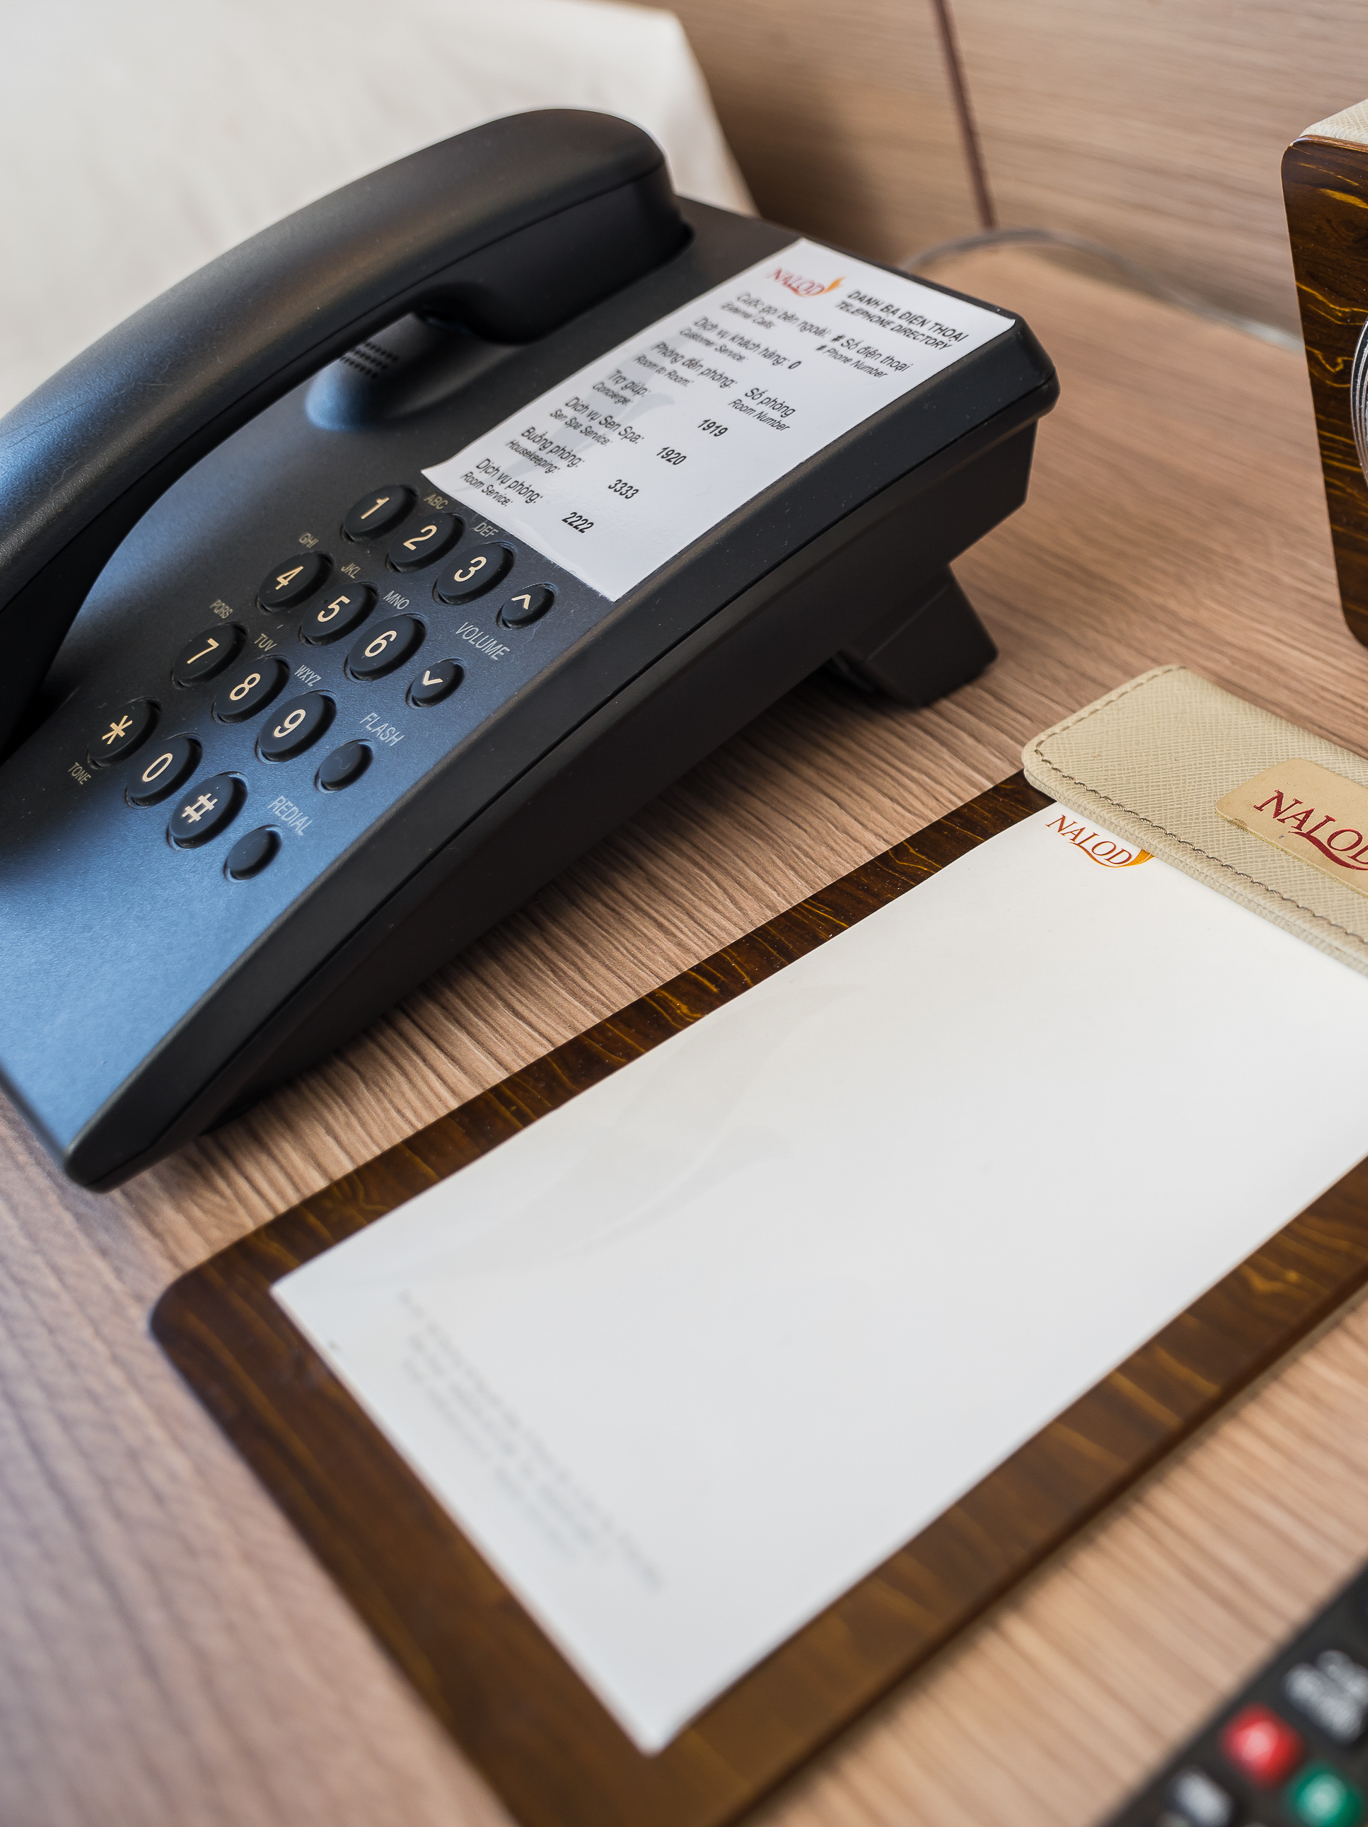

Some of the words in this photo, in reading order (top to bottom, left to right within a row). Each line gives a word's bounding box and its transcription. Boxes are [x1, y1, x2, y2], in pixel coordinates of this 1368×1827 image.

[768, 267, 832, 297] NALOD
[835, 300, 894, 329] TELEPHONE
[890, 323, 952, 350] DIRECTORY
[848, 290, 881, 309] DANH
[880, 304, 900, 317] BẠ
[899, 310, 932, 328] ĐIỆN
[930, 321, 969, 342] THOẠI
[634, 353, 663, 374] Room
[824, 348, 852, 365] Phone
[852, 359, 888, 378] Number
[841, 338, 864, 351] Số
[857, 344, 882, 360] điện
[880, 355, 914, 372] thoại
[729, 398, 756, 415] Room
[754, 408, 791, 432] Number
[745, 387, 768, 400] Số
[760, 395, 796, 418] phòng
[550, 408, 568, 422] Sen
[565, 417, 582, 430] Spa
[580, 424, 613, 447] Service:
[565, 396, 589, 416] Dịch
[586, 410, 601, 422] vụ
[599, 415, 620, 433] Sen
[618, 426, 645, 445] Spa:
[697, 419, 728, 437] 1919
[506, 439, 560, 474] Housekeeping:
[521, 426, 552, 451] Buồng
[549, 444, 585, 468] phòng:
[656, 447, 687, 466] 1920
[476, 458, 500, 478] Dịch
[498, 471, 512, 485] vụ
[507, 479, 543, 504] phòng:
[608, 479, 639, 500] 3333
[361, 496, 390, 520] 1
[424, 493, 449, 510] ABC
[461, 471, 485, 490] Room
[482, 484, 513, 507] Service:
[562, 511, 594, 534] 2222
[298, 532, 319, 549] GHI
[403, 525, 438, 551] 2
[473, 521, 499, 538] DEF
[275, 565, 304, 591] 4
[341, 563, 362, 579] JKL
[454, 556, 487, 582] 3
[209, 599, 233, 619] PQRS
[317, 595, 351, 622] 5
[383, 590, 410, 610] MNO
[187, 637, 220, 664] 7
[254, 633, 277, 651] TUV
[364, 630, 398, 657] 6
[455, 621, 510, 661] VOLUME
[229, 672, 261, 701] 8
[294, 664, 322, 687] WXYZ
[273, 708, 307, 738] 9
[360, 712, 405, 747] FLASH
[68, 762, 92, 785] TONE
[142, 752, 173, 783] 0
[267, 795, 313, 836] REDIAL
[1045, 813, 1138, 869] NALOD
